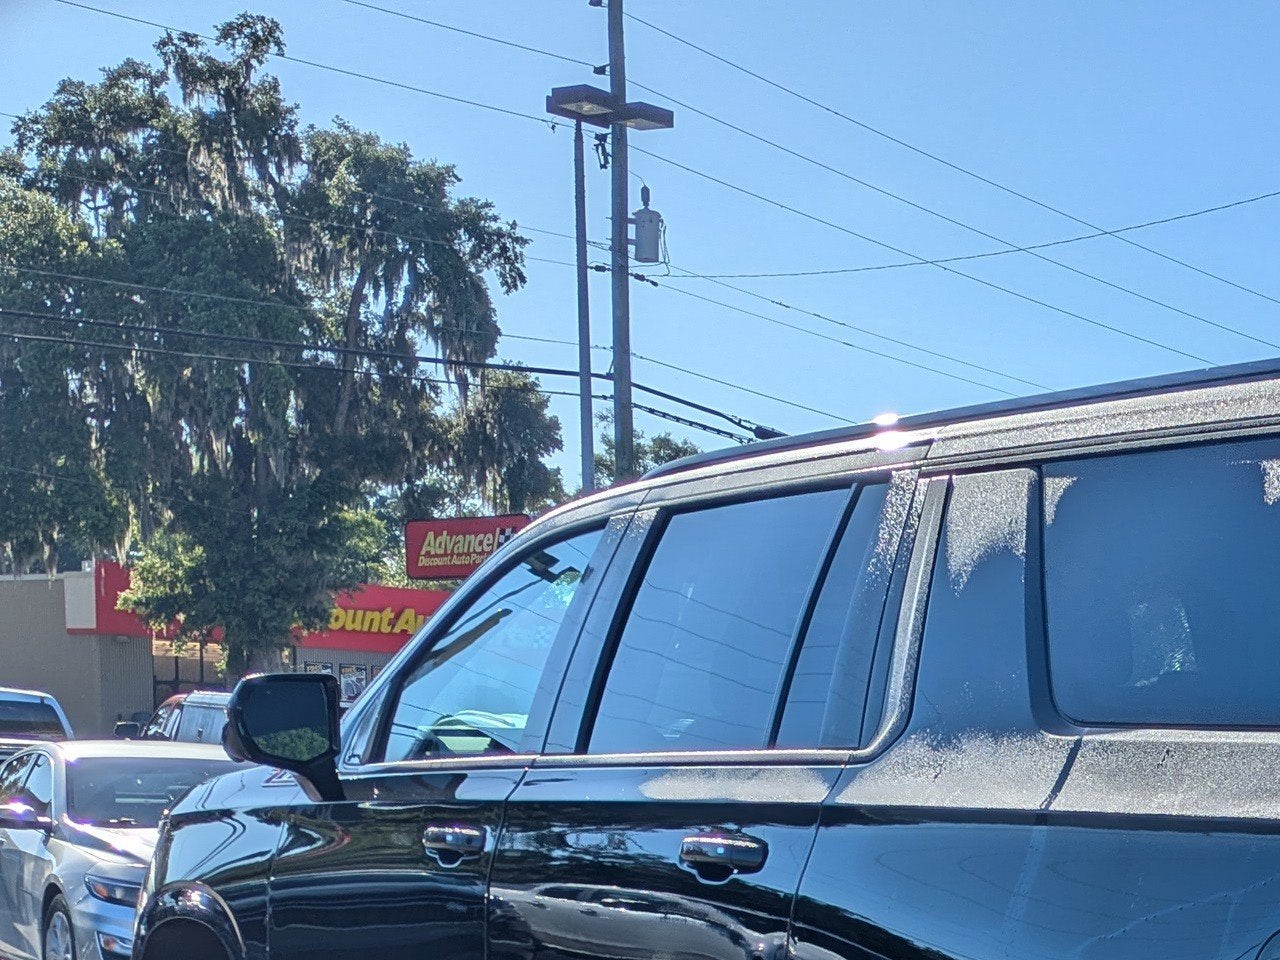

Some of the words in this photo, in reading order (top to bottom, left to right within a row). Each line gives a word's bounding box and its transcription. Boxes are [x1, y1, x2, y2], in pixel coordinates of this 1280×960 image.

[420, 530, 494, 555] Advance
[418, 555, 452, 567] Discount
[451, 554, 470, 565] Auto
